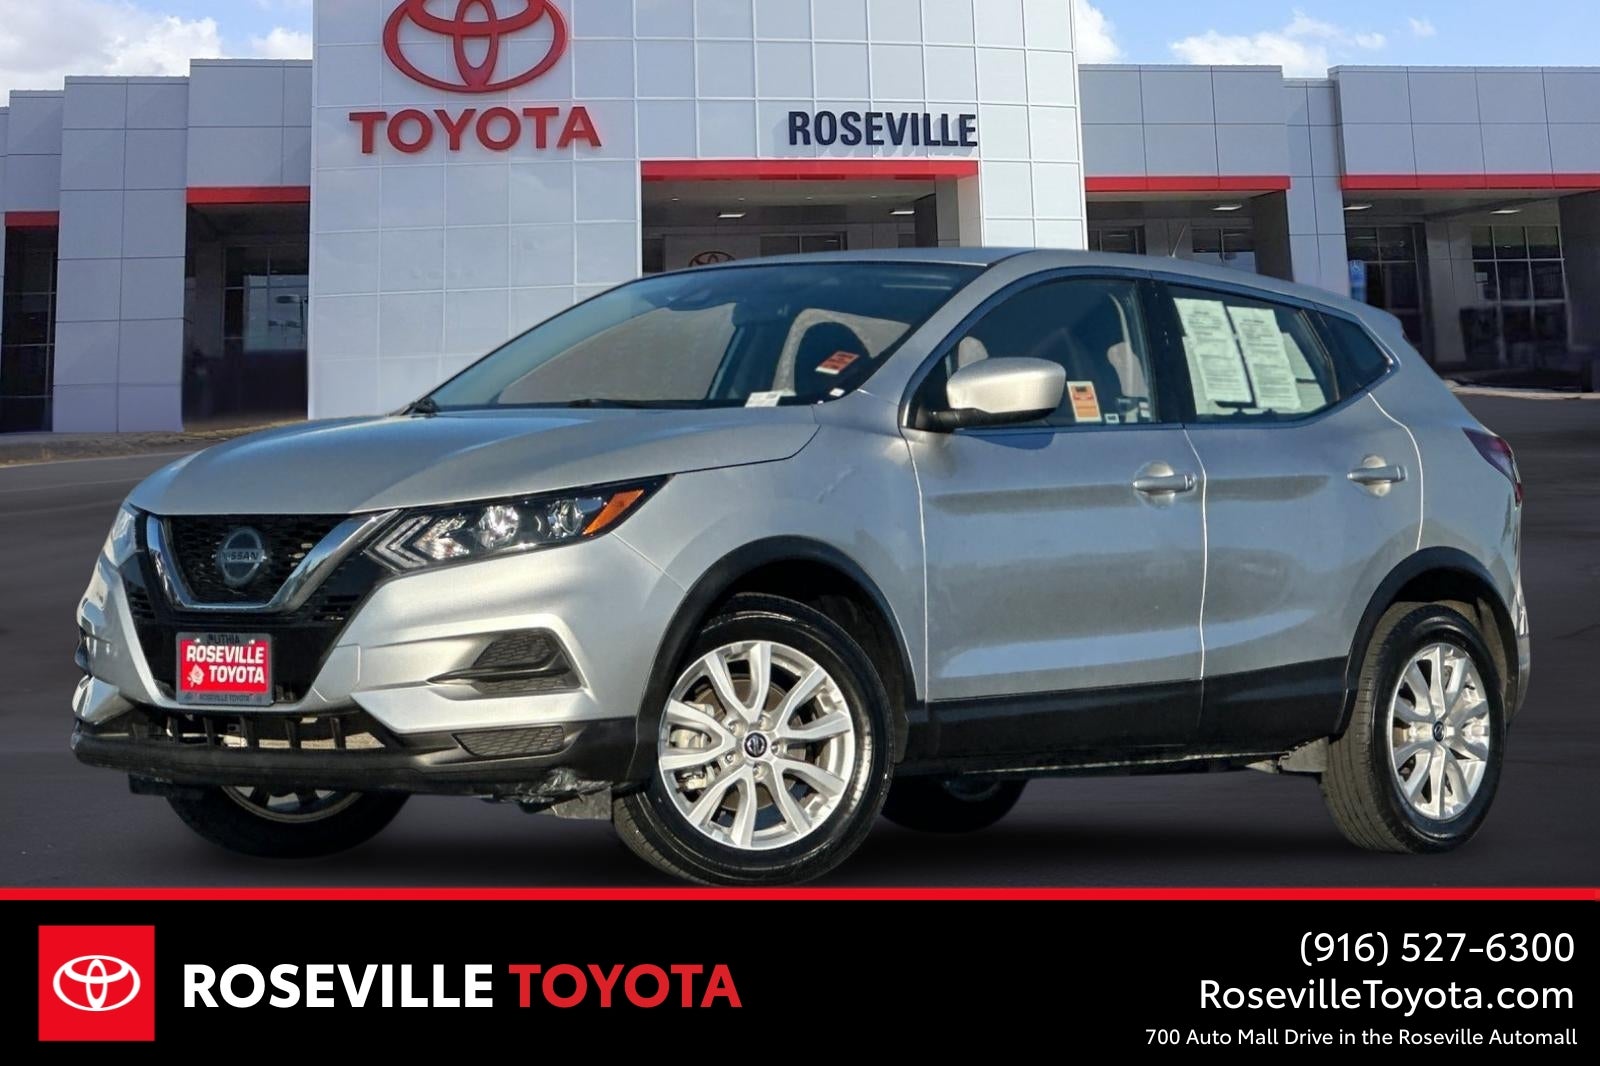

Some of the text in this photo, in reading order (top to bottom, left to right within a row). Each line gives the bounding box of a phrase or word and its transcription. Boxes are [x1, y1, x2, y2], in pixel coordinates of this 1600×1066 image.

[349, 106, 602, 154] TOYOTA
[788, 111, 978, 147] ROSEVILLE
[223, 551, 259, 561] NISSAN
[186, 645, 265, 664] ROSEVILLE
[209, 665, 265, 684] TOYOTA
